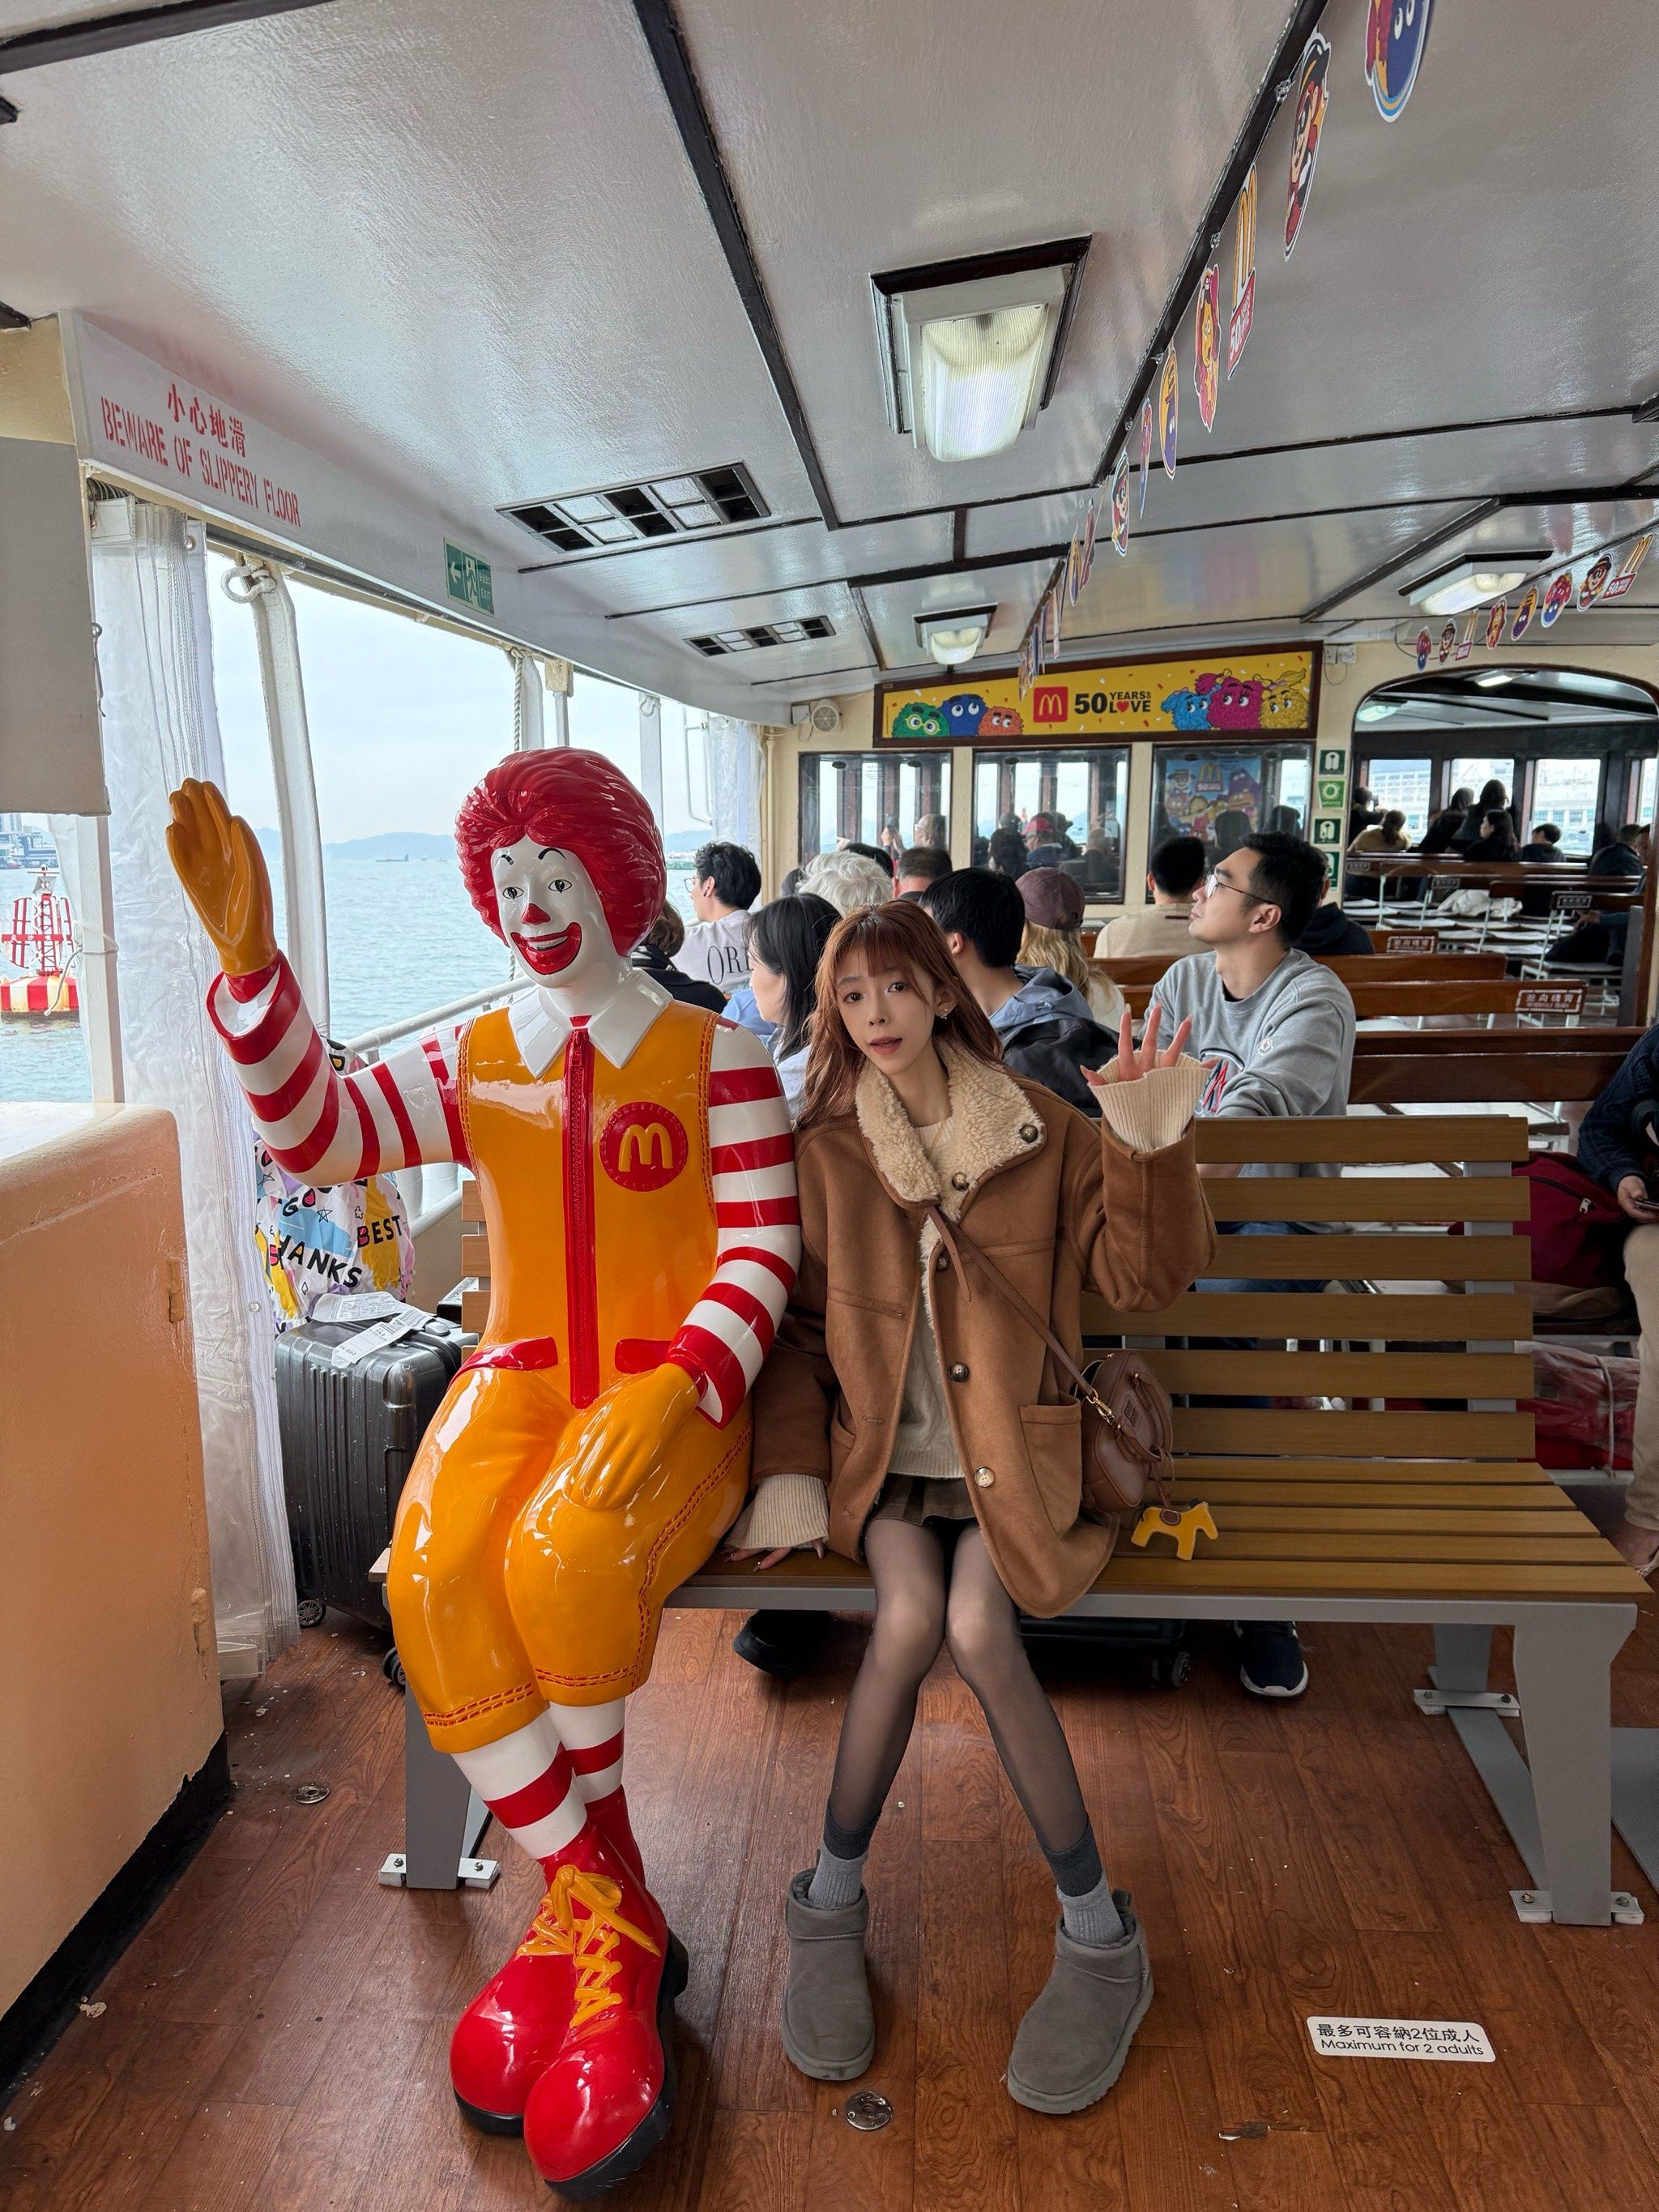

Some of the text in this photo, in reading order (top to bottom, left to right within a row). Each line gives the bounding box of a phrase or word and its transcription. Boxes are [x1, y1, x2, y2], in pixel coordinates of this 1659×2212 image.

[168, 383, 245, 458] 小心地滑
[101, 396, 301, 527] BEWARE OF SLIPPERY FLOOR
[1074, 692, 1108, 715] 50
[1109, 690, 1145, 700] YEARS
[357, 1215, 402, 1249] BEST
[1317, 2023, 1480, 2043] 最多可容納2位成人
[1321, 2039, 1484, 2055] Maximum for 2 adults
